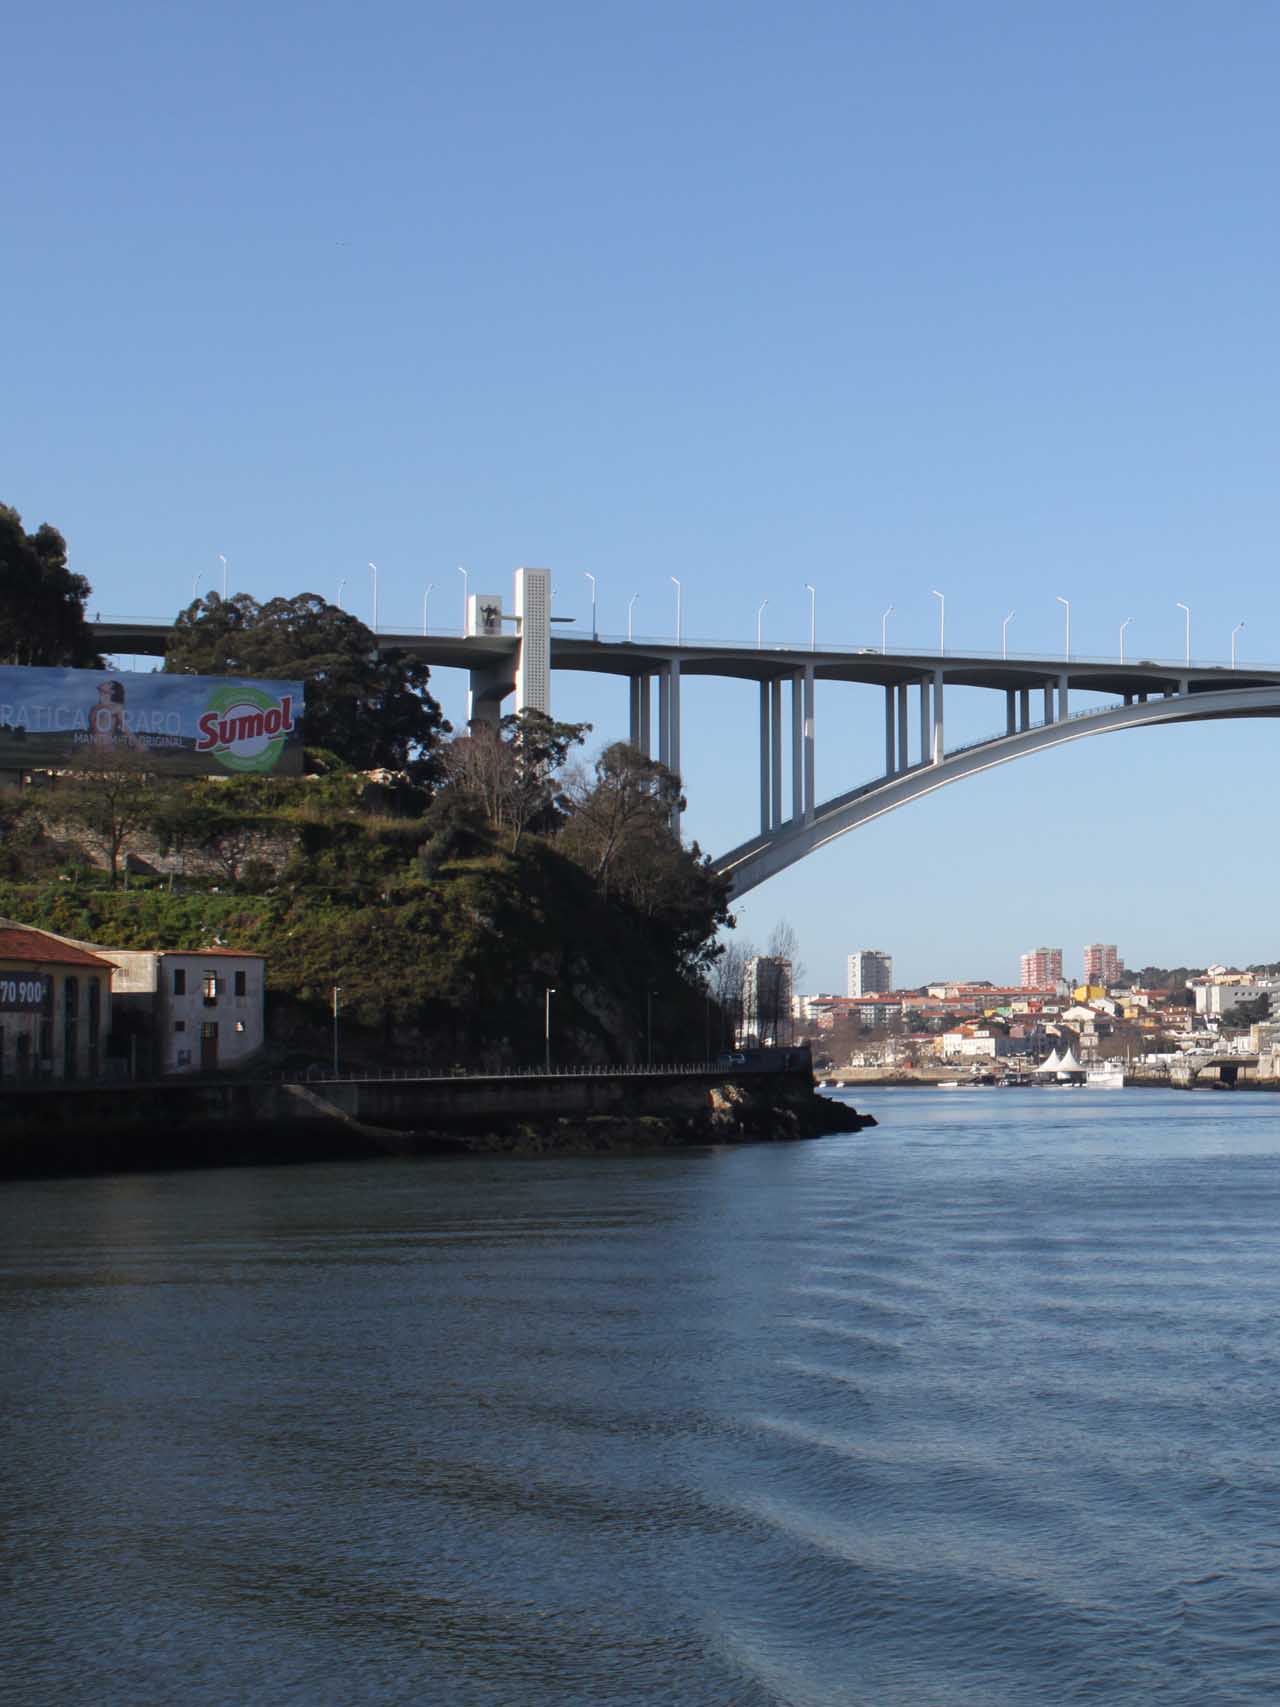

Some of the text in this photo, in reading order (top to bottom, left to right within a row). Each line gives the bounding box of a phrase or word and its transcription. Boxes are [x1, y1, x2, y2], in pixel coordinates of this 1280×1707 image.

[95, 706, 112, 732] O
[122, 710, 182, 736] RARO
[196, 695, 294, 750] Sumol
